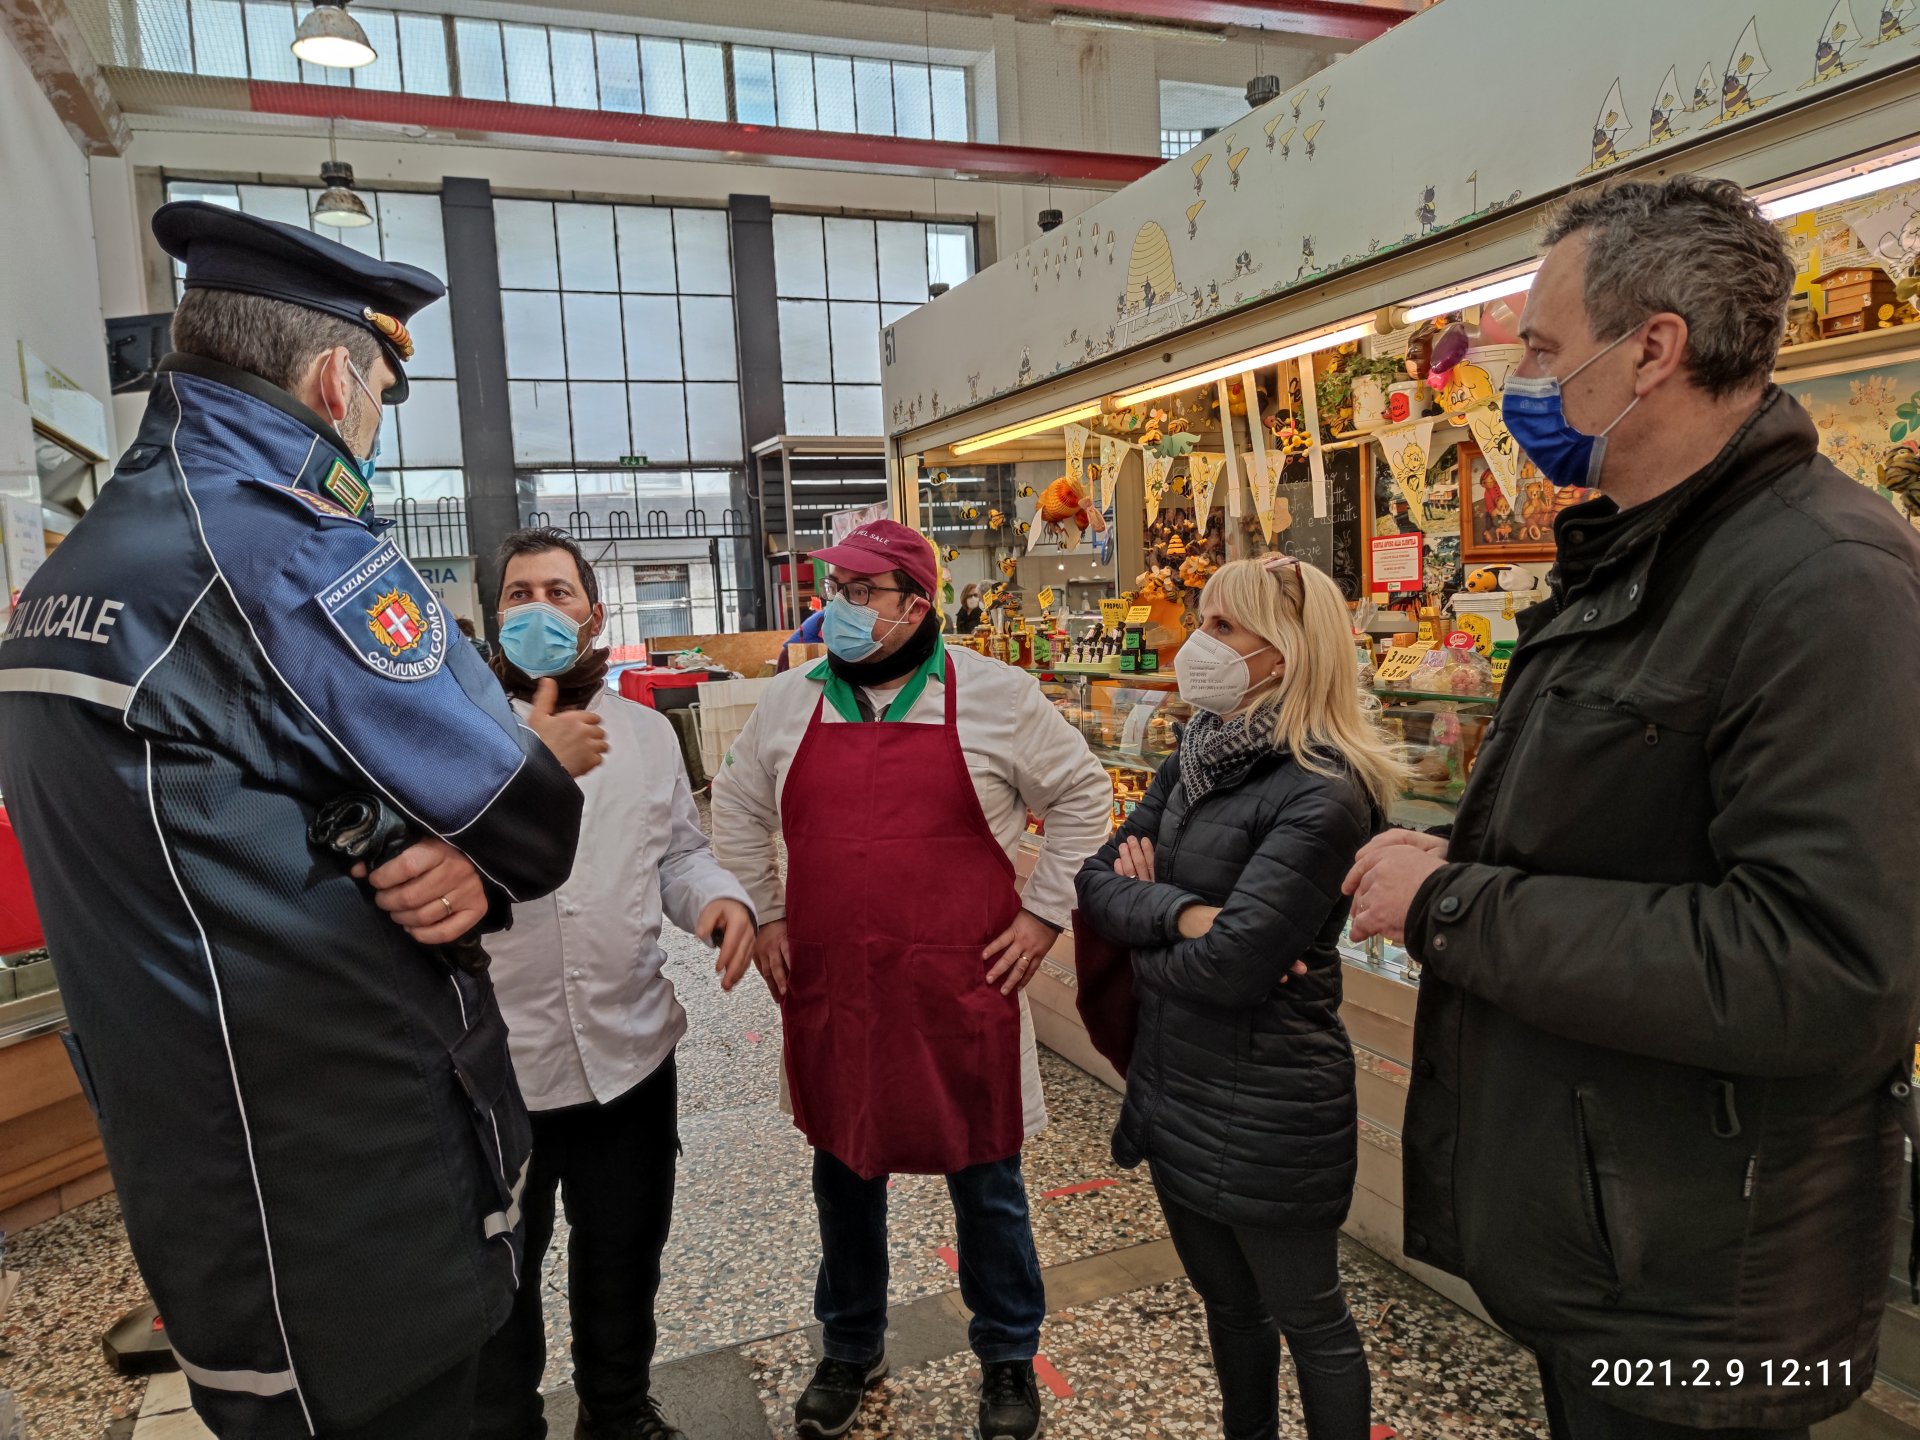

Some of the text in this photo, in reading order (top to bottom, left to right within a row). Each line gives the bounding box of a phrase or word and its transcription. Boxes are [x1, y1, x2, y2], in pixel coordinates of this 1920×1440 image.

[885, 327, 896, 367] 51
[869, 533, 890, 546] SALE
[1284, 537, 1321, 561] Grazie
[326, 546, 397, 607] POLIZIA LOCALE
[1103, 602, 1123, 610] PROPOLI
[24, 594, 125, 644] LOCALE
[368, 602, 442, 676] COMUNE DI COMO
[1388, 650, 1398, 663] 3
[1397, 656, 1420, 665] PEZZI
[1381, 668, 1389, 677] €
